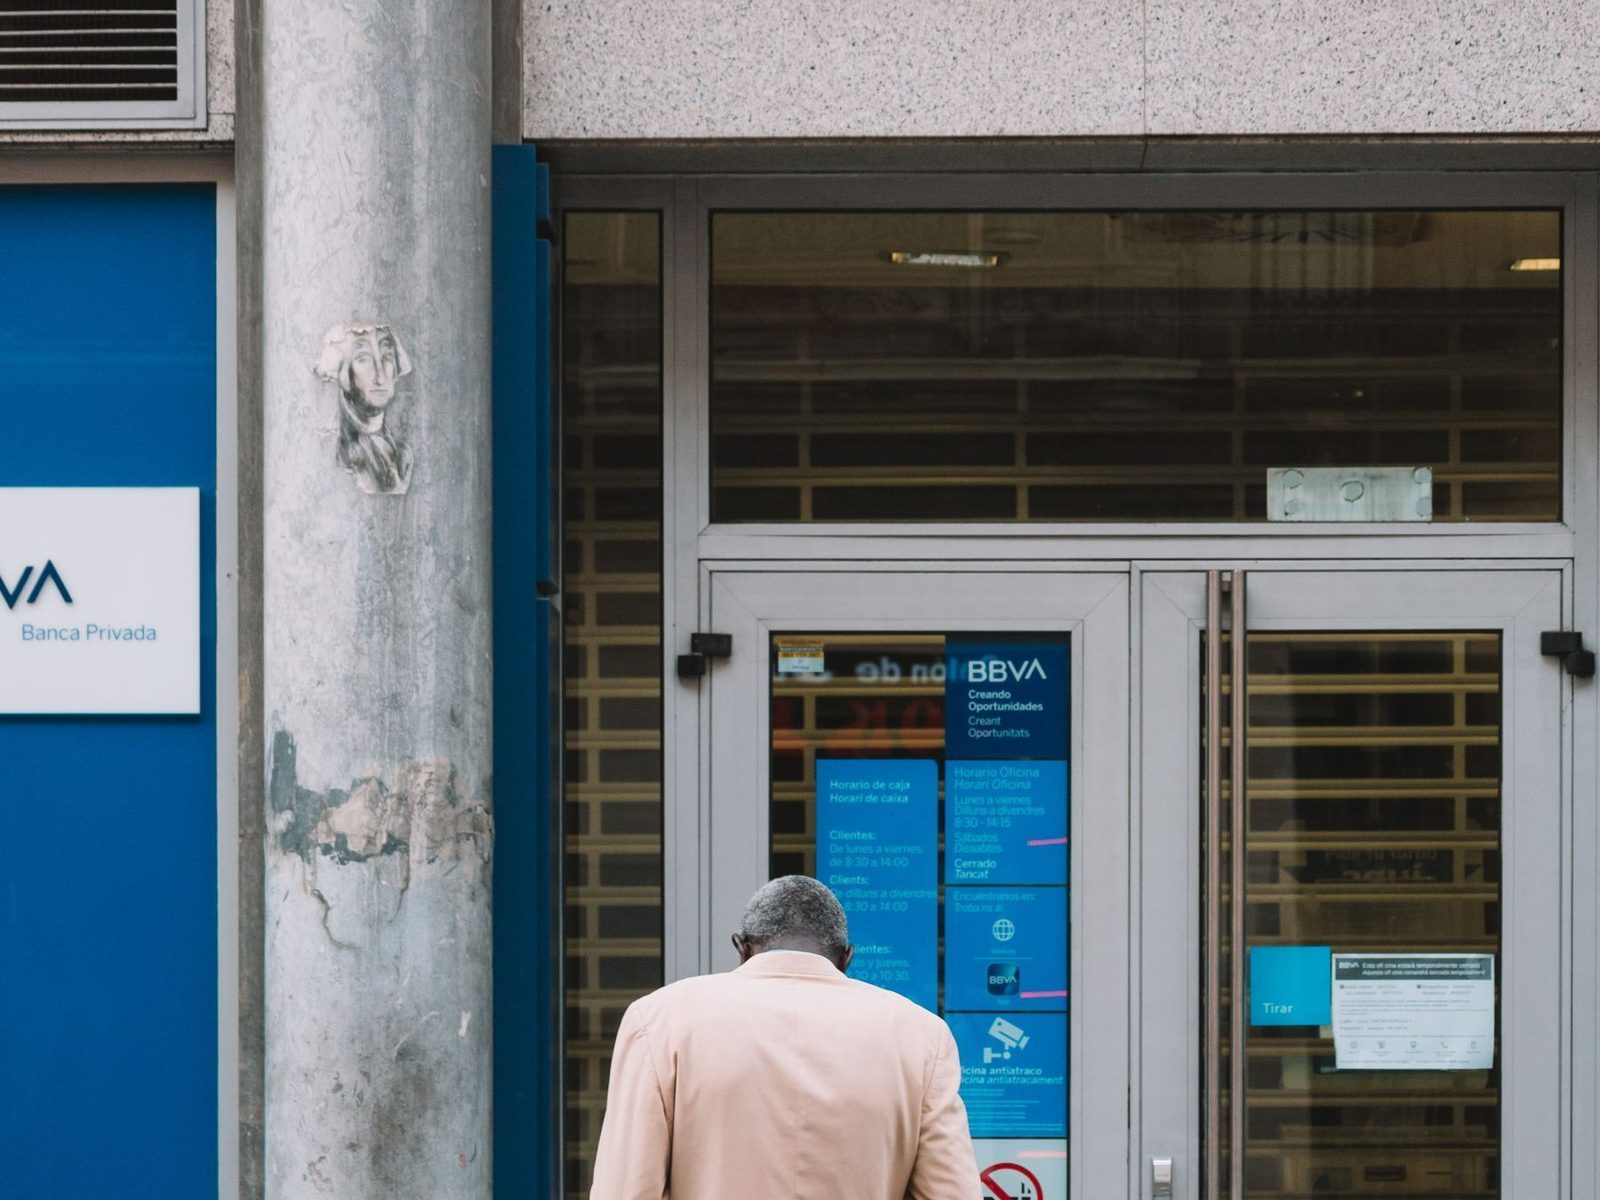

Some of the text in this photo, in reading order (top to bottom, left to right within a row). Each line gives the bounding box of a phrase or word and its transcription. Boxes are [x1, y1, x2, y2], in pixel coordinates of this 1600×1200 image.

[0, 559, 73, 610] VA
[22, 623, 157, 641] Banca Privada
[968, 658, 1047, 682] BBVA
[968, 689, 1011, 699] Creando
[968, 702, 1043, 712] Oportunidades
[968, 716, 1001, 726] Creant
[968, 728, 1030, 739] Oportunitats
[954, 766, 1040, 777] Horario Oficina
[830, 780, 911, 791] Horario de caja
[954, 778, 1031, 789] Horari Oficina
[830, 793, 909, 803] Horari de caixa
[954, 795, 985, 805] Lunes
[830, 830, 876, 840] Clientes:
[954, 858, 997, 869] Cerrado
[955, 869, 988, 879] Tancat
[830, 874, 870, 885] Clients:
[854, 944, 893, 954] lientes:
[989, 976, 1017, 985] BBVA
[1262, 1002, 1294, 1014] Tirar
[989, 1066, 1042, 1075] antiatraco
